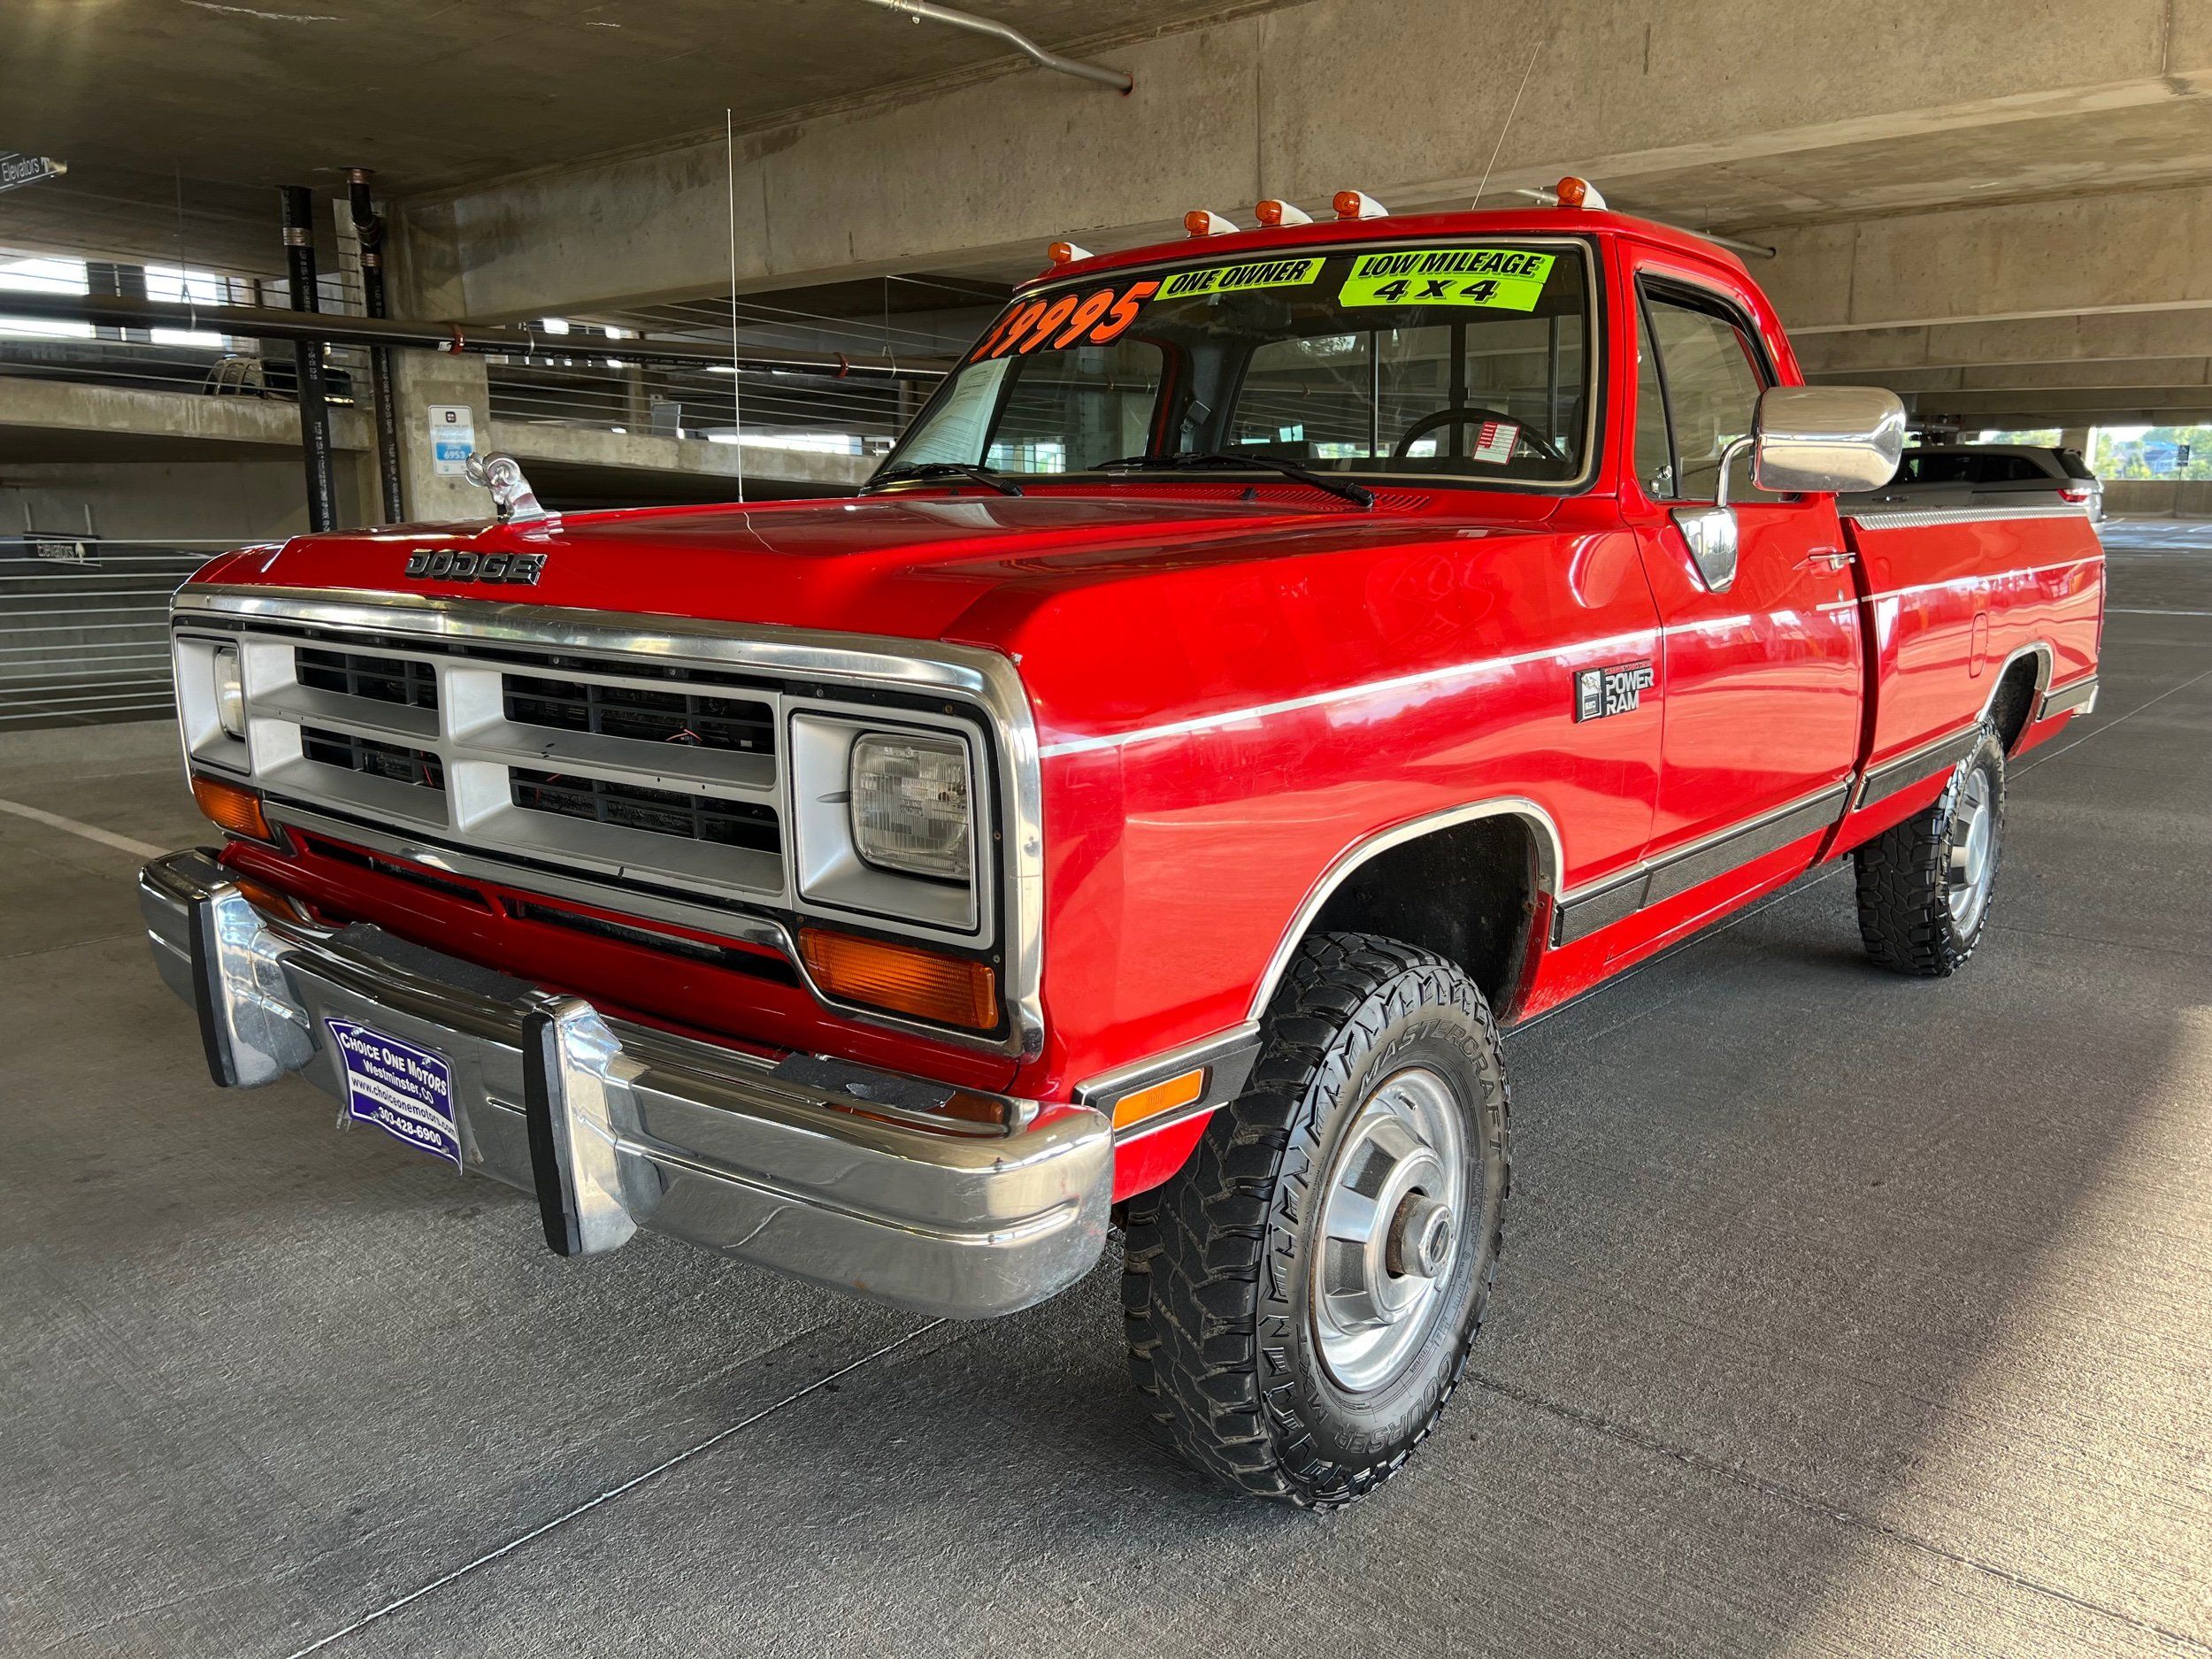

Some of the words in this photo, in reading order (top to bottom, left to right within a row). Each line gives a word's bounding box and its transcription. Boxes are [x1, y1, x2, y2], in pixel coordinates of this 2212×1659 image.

[2, 157, 40, 181] Elevators
[1166, 269, 1222, 296] ONE
[1217, 259, 1314, 289] OWNER
[1358, 253, 1422, 279] LOW
[1417, 251, 1546, 279] MILEAGE
[1372, 279, 1413, 303] 4
[1459, 279, 1502, 304] 4
[443, 450, 466, 459] 6953
[404, 549, 548, 586] DODGE
[1605, 667, 1655, 695] POWER
[1606, 690, 1640, 716] RAM
[340, 1032, 381, 1062] CHOICE
[382, 1048, 406, 1072] ONE
[407, 1058, 447, 1096] MOTORS
[363, 1059, 422, 1099] Westminster,
[420, 1087, 434, 1104] CO
[353, 1078, 457, 1136] www.choiceonemotors.com
[1358, 1018, 1502, 1161] MASTERCRAFT
[379, 1107, 442, 1146] 303-428-6900
[1333, 1351, 1453, 1455] COURSER
